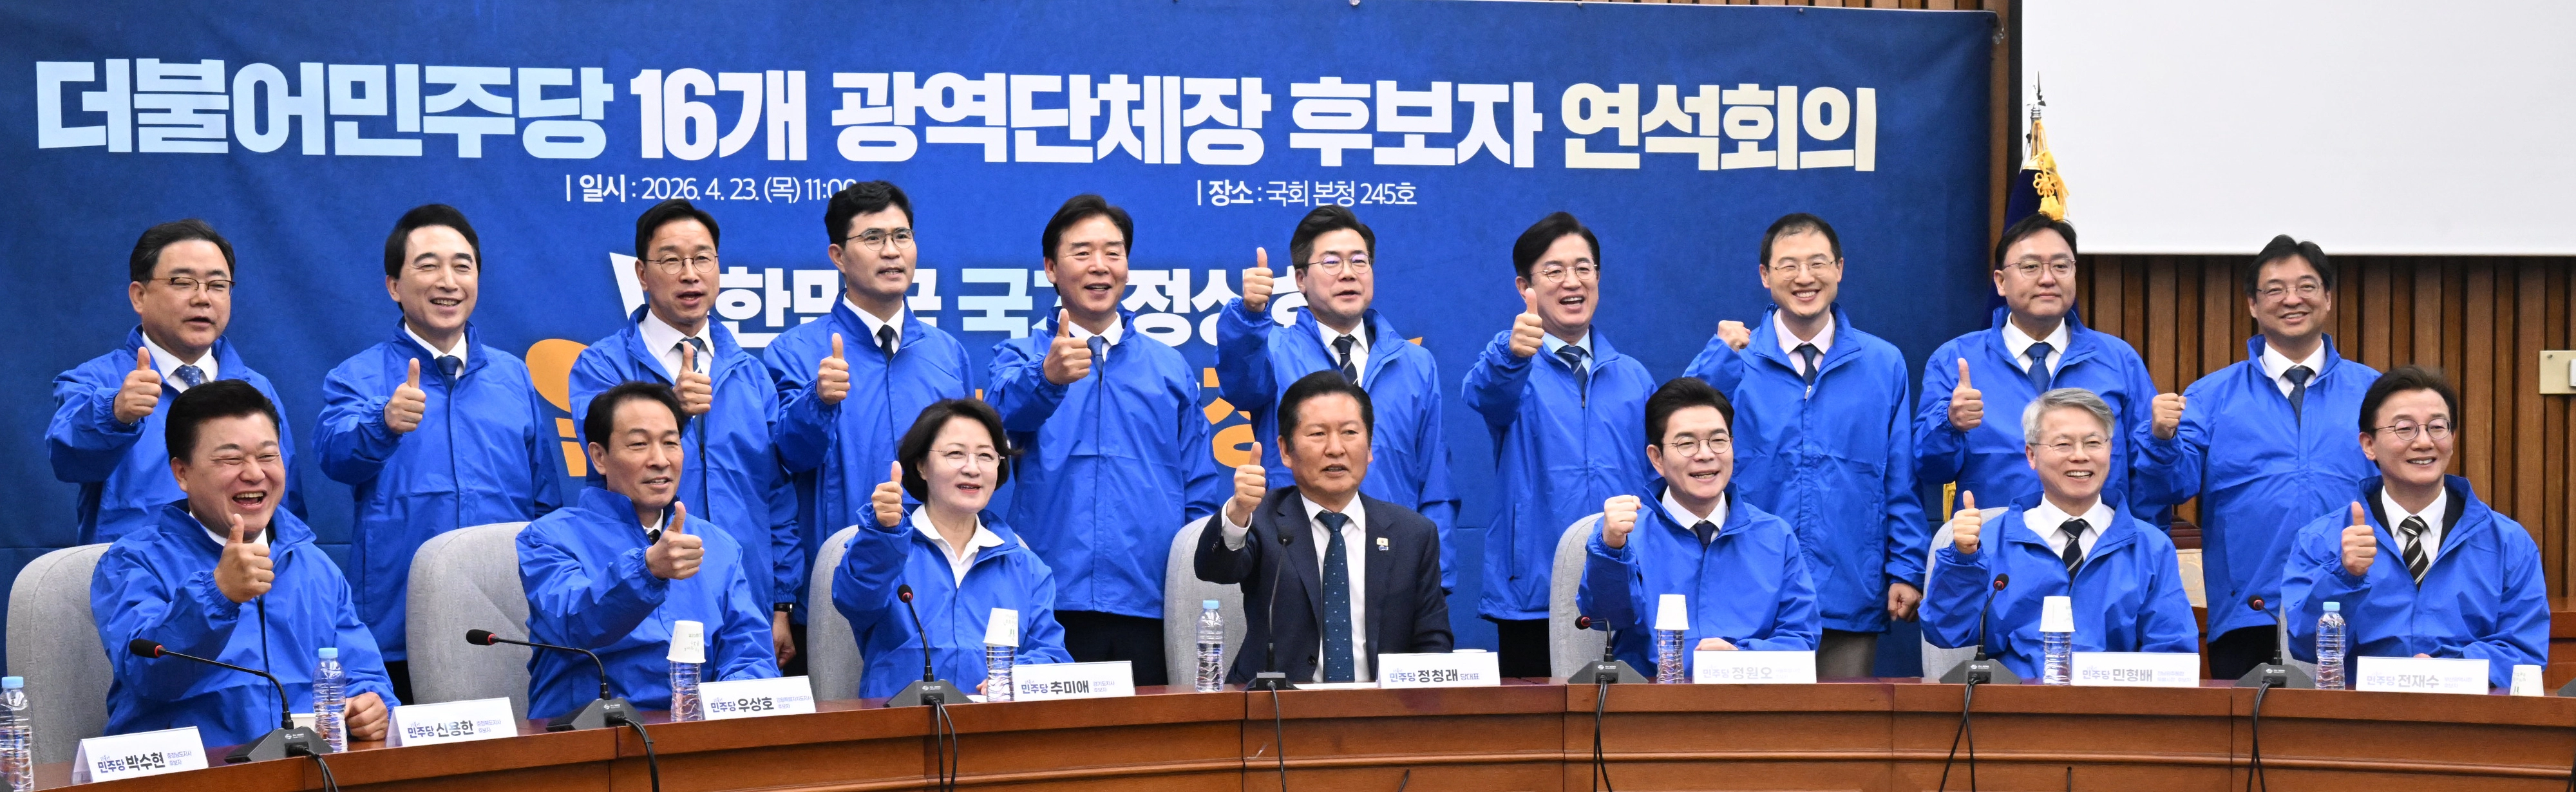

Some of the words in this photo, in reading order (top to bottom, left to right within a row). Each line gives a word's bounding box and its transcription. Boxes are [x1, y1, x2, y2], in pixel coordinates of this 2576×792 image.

[37, 59, 614, 159] 더불어민주당
[630, 68, 807, 161] 16개
[831, 71, 1271, 165] 광역단체장
[1290, 77, 1542, 167] 후보자
[1562, 82, 1877, 171] 연석회의
[579, 174, 626, 203] 일시
[641, 178, 701, 200] 2026.
[705, 178, 724, 200] 4.
[730, 178, 760, 200] 23.
[764, 176, 800, 203] (목)
[805, 178, 857, 200] 11:0
[1208, 179, 1254, 207] 장소
[1266, 180, 1309, 207] 국회
[1312, 180, 1355, 207] 본청
[1360, 182, 1417, 205] 245호
[1389, 672, 1416, 683] 민주당
[1417, 669, 1458, 683] 정청래
[1703, 668, 1730, 679] 민주당
[1732, 666, 1773, 680] 정원오
[2082, 670, 2110, 680] 민주당
[2112, 668, 2153, 683] 민형배
[1021, 684, 1048, 694] 민주당
[1050, 680, 1090, 695] 추미애
[2366, 675, 2395, 687] 민주당
[2398, 674, 2440, 689] 전재수
[710, 701, 736, 713] 민주당
[737, 697, 774, 713] 우상호
[407, 726, 435, 739] 민주당
[436, 721, 474, 738] 신용한
[97, 759, 126, 773] 민주당
[126, 751, 166, 771] 박수현
[167, 750, 192, 759] 충청남도지사
